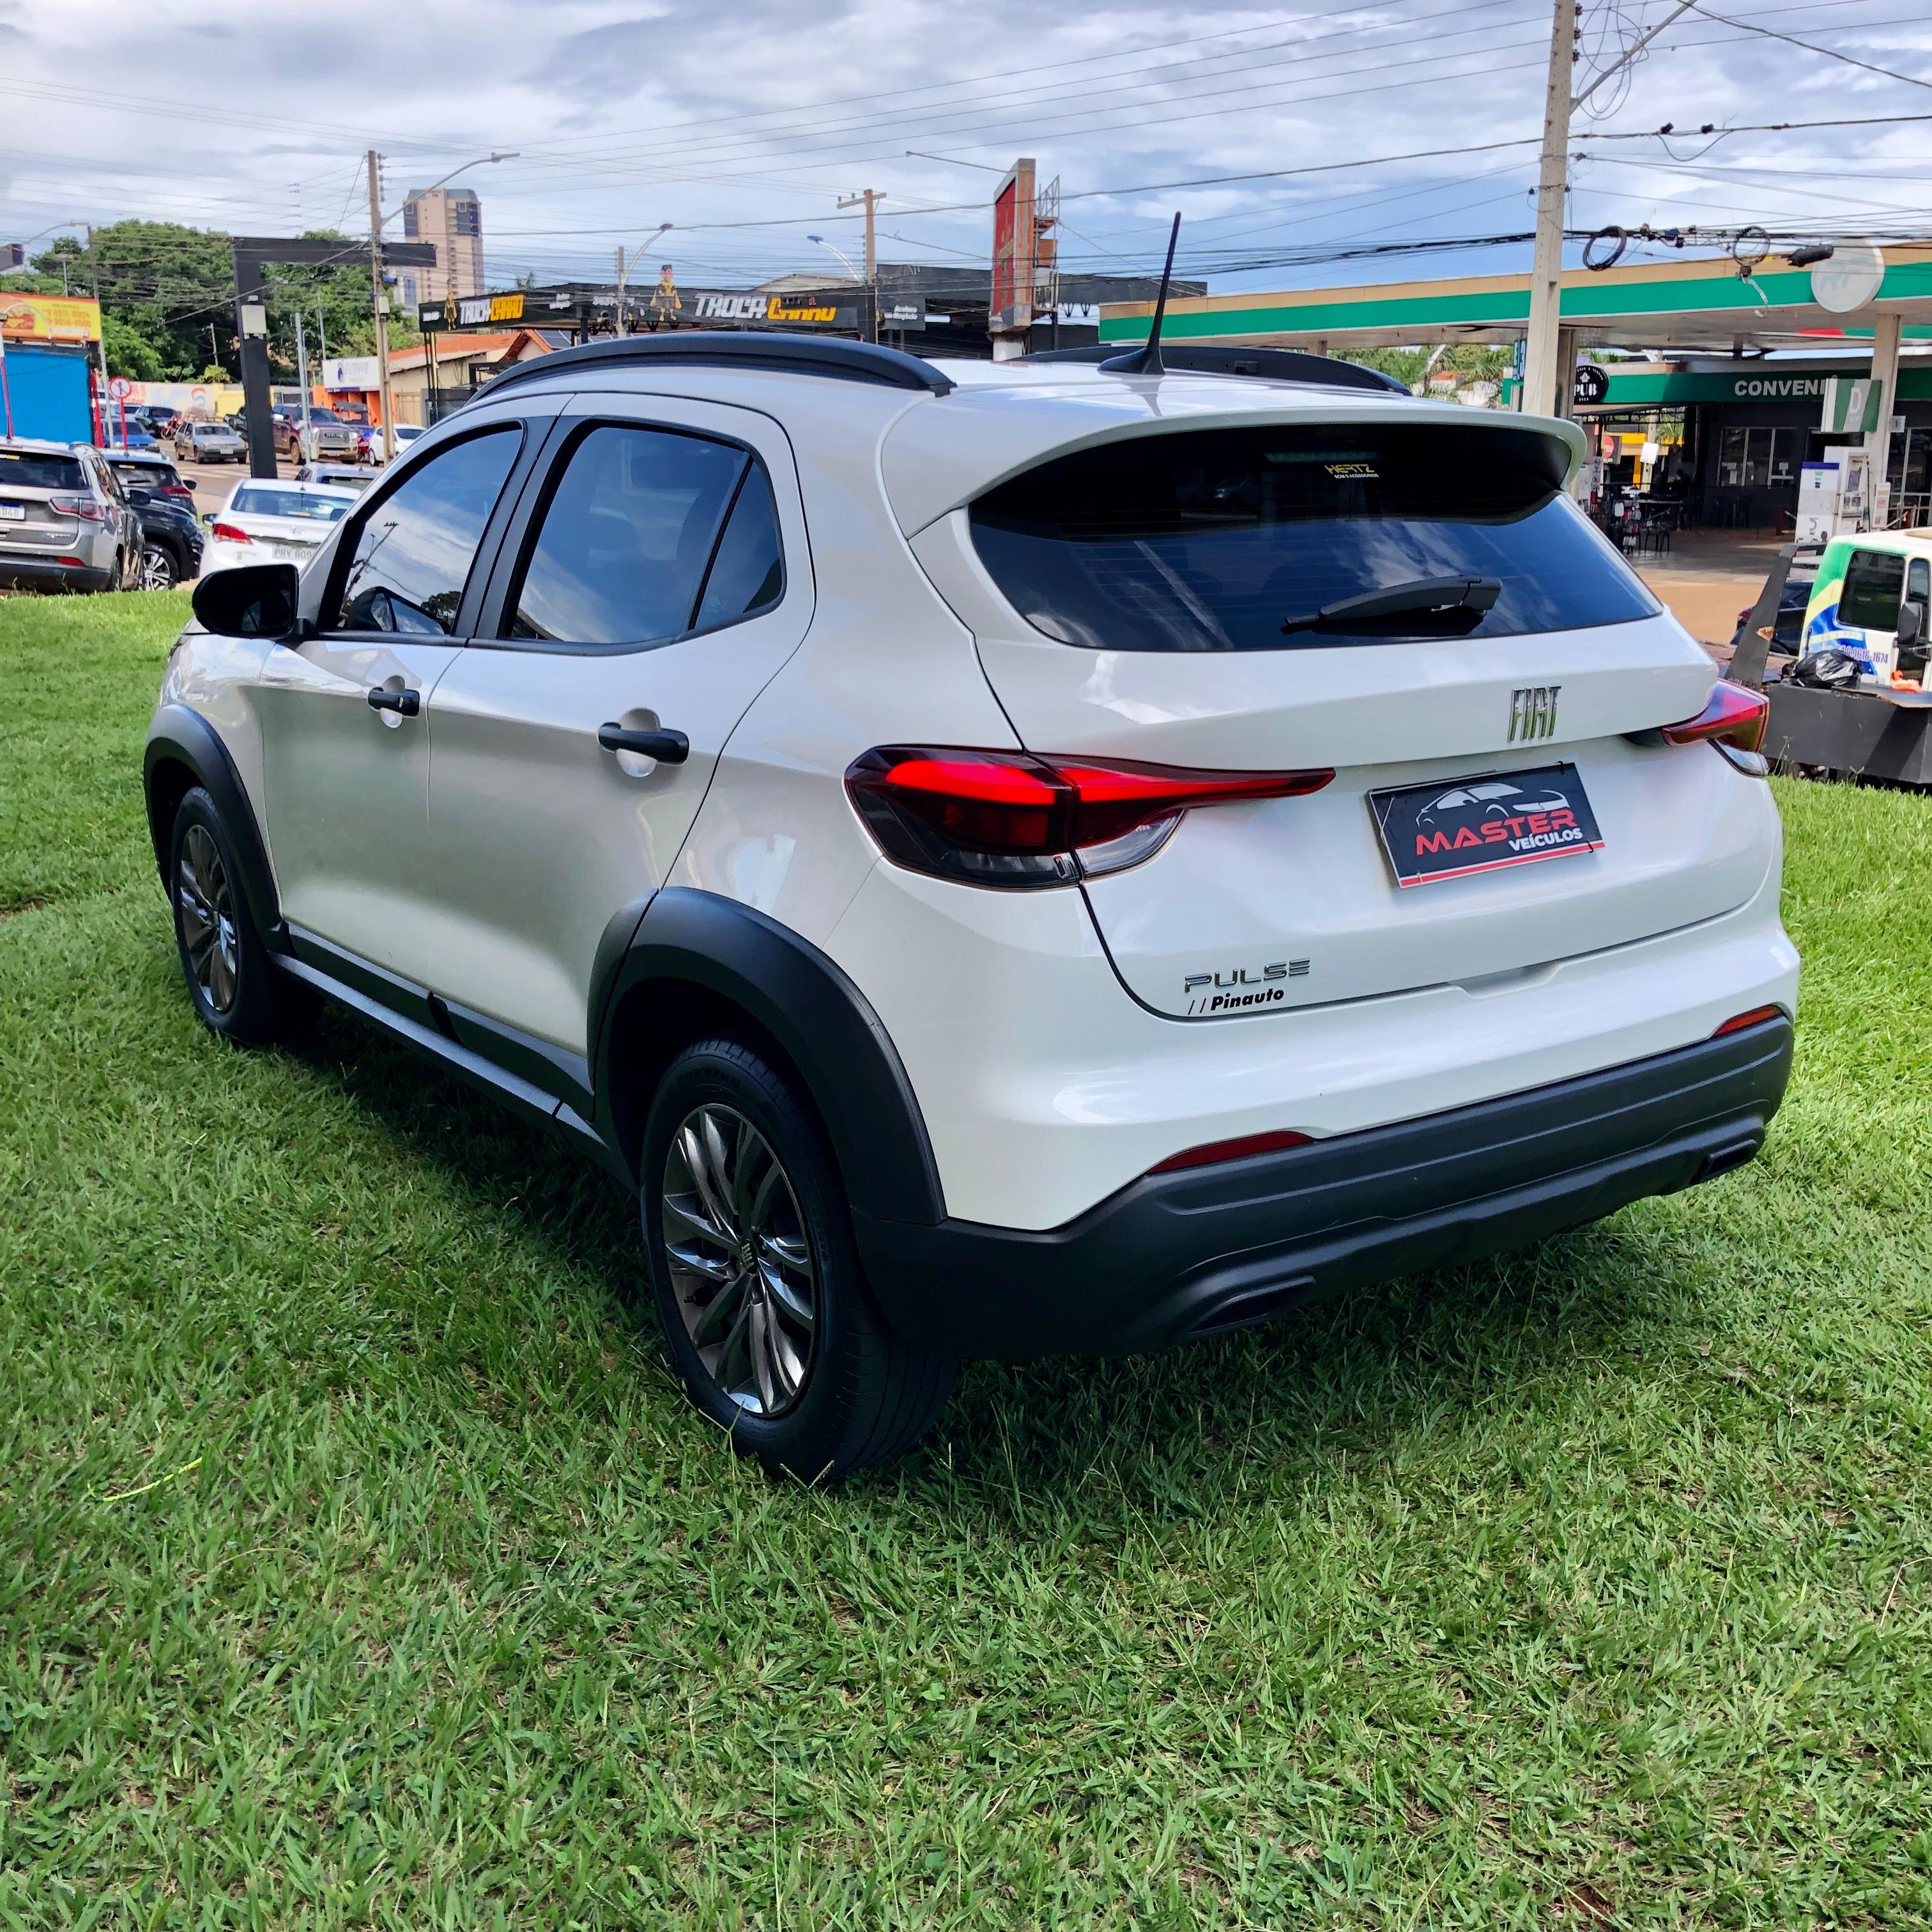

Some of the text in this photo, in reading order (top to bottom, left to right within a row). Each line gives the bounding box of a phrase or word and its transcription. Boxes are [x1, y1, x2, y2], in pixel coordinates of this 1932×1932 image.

[694, 293, 767, 319] TROCA
[1574, 383, 1597, 396] PUB
[1735, 379, 1825, 396] CONVENI
[1324, 464, 1375, 474] HERTZ
[1507, 686, 1562, 742] FIAT
[1416, 808, 1578, 856] MASTER
[1508, 827, 1583, 852] VEÍCULOS
[1184, 958, 1310, 993] PULSE
[1210, 988, 1284, 1011] Pinauto
